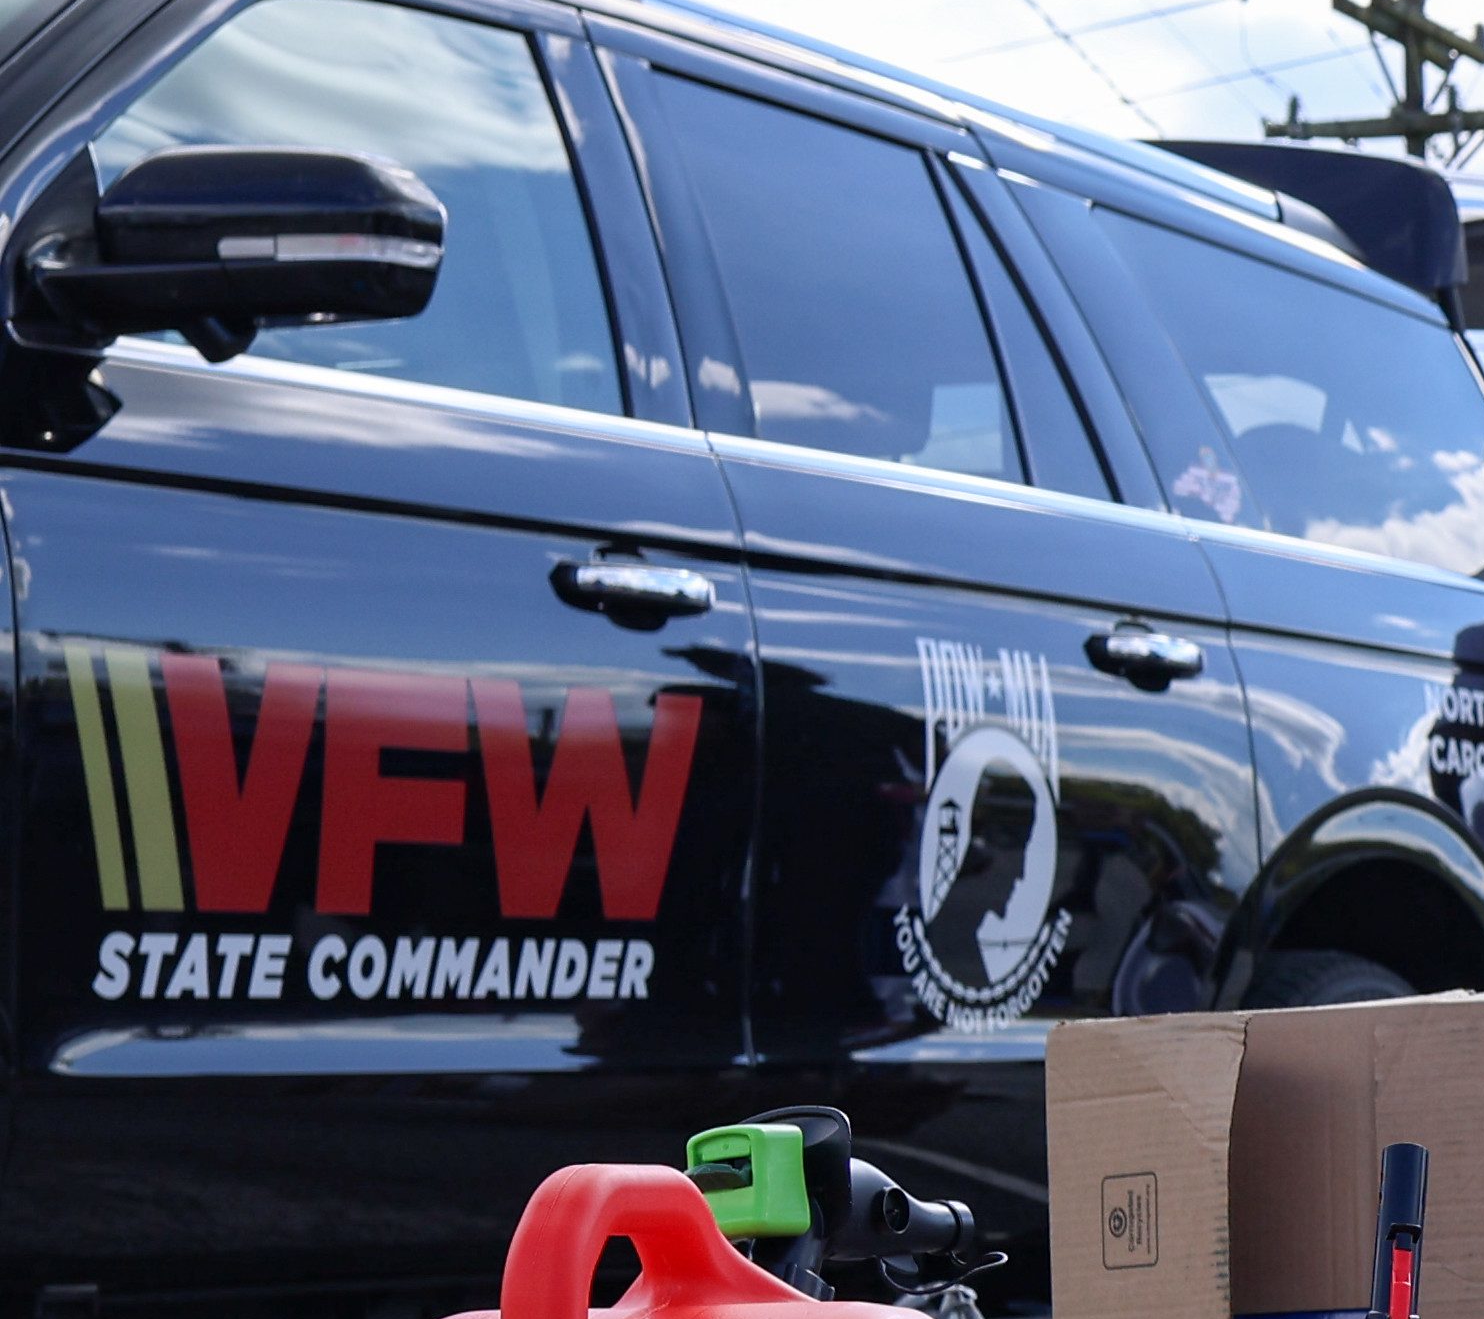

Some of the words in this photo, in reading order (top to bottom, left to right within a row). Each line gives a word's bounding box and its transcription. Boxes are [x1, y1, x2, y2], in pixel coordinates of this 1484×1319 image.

[160, 652, 703, 920] VFW
[92, 931, 292, 1000] STATE
[308, 933, 655, 999] COMMANDER
[892, 902, 922, 974] YOU
[911, 975, 947, 1021] ARE
[985, 906, 1074, 1034] FORGOTTEN
